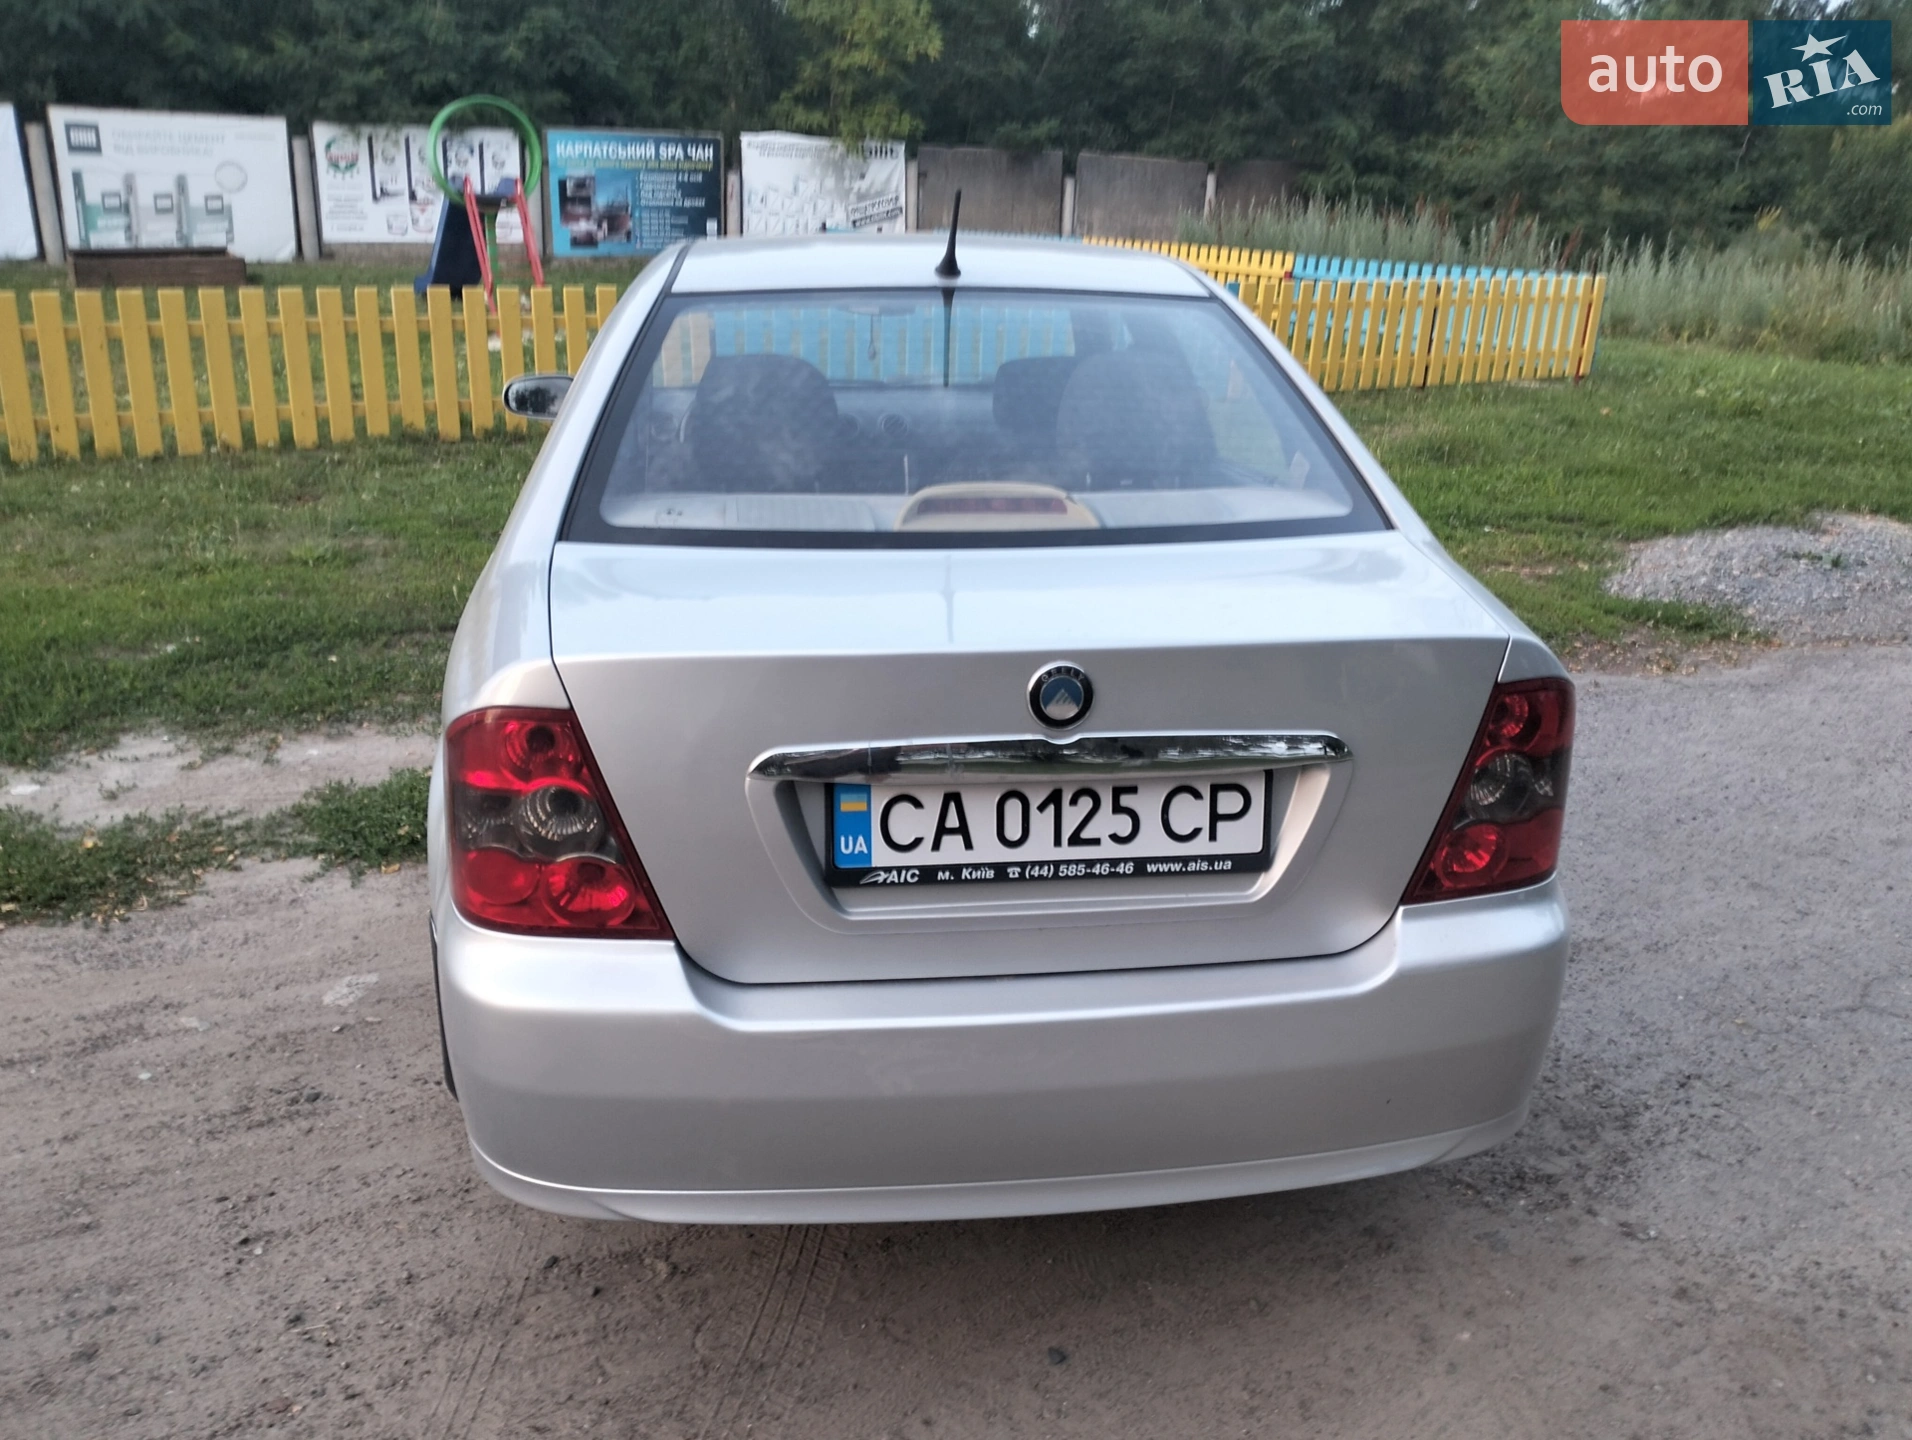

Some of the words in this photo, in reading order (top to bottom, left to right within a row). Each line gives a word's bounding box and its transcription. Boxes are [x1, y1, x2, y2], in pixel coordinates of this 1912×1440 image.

[557, 140, 656, 159] КАРПАТСЬКИЙ
[659, 143, 685, 161] SPA
[687, 143, 714, 162] ЧАН
[1041, 667, 1085, 682] GEELY
[879, 791, 974, 853] CA
[995, 785, 1141, 849] 0125
[1160, 783, 1252, 843] CP
[839, 834, 868, 855] UA
[937, 872, 955, 881] м.
[961, 867, 995, 880] Київ
[1025, 864, 1054, 879] (44)
[1059, 862, 1135, 877] 585-46-46
[1146, 859, 1232, 873] www.ais.ua
